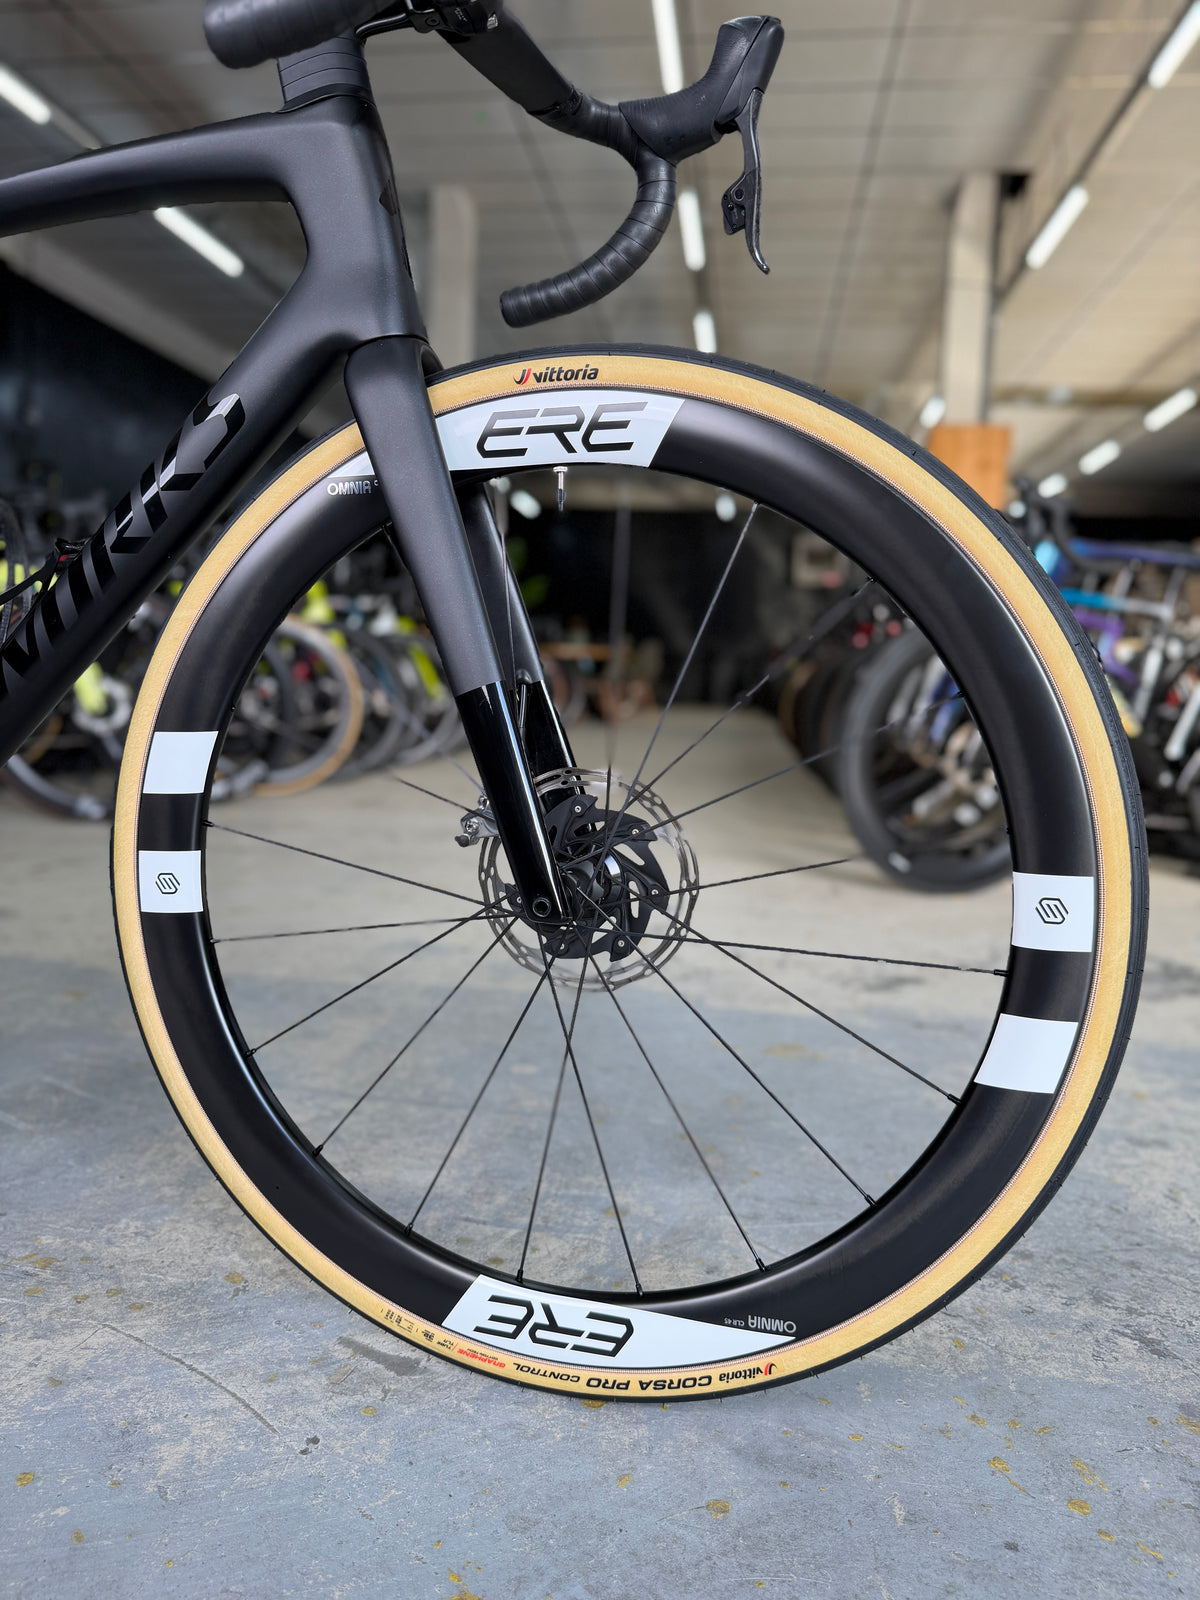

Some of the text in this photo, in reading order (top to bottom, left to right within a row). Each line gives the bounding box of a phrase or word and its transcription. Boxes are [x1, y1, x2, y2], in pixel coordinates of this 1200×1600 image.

[534, 364, 599, 383] vittoria
[476, 402, 648, 459] ERE
[327, 480, 371, 496] OMNIA
[473, 1294, 634, 1358] ERE
[748, 1314, 797, 1334] OMNIA
[457, 1348, 506, 1369] GRAPHENE
[512, 1362, 763, 1391] vittoria CORSA PRO CONTROL
